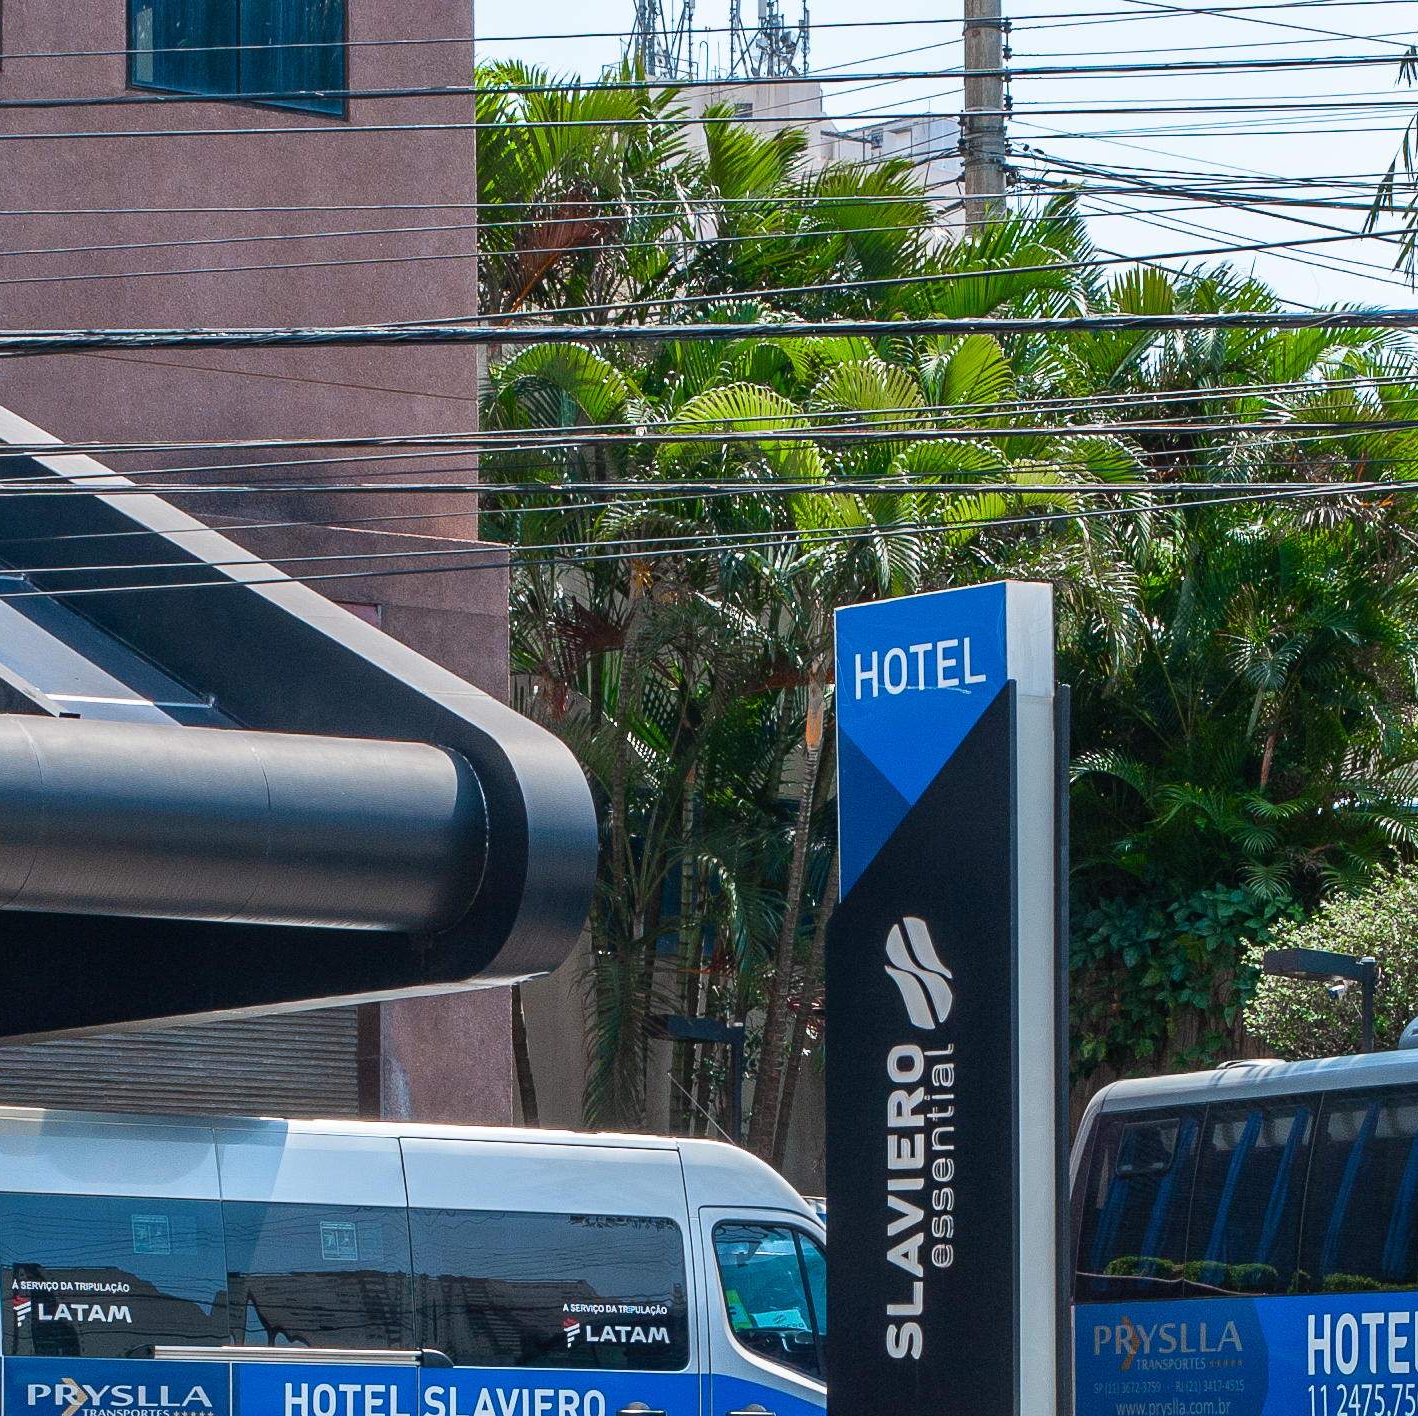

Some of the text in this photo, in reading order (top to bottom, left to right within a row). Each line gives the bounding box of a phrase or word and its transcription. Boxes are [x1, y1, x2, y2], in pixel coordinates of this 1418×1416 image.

[854, 637, 987, 700] HOTEL
[926, 1042, 956, 1269] essential
[886, 1043, 925, 1360] SLAVIERO
[20, 1281, 59, 1292] SERVIÇO
[60, 1282, 74, 1291] DA
[74, 1282, 130, 1293] TRIPULAÇÃO
[38, 1303, 132, 1323] LATAM
[570, 1303, 604, 1315] SERVIÇO
[605, 1304, 618, 1314] DA
[618, 1304, 668, 1316] TRIPULAÇÃO
[585, 1325, 671, 1344] LATAM
[1094, 1320, 1243, 1355] PRYSLLA
[1136, 1357, 1206, 1370] TRANSPORTES
[27, 1382, 213, 1408] PRYSLLA
